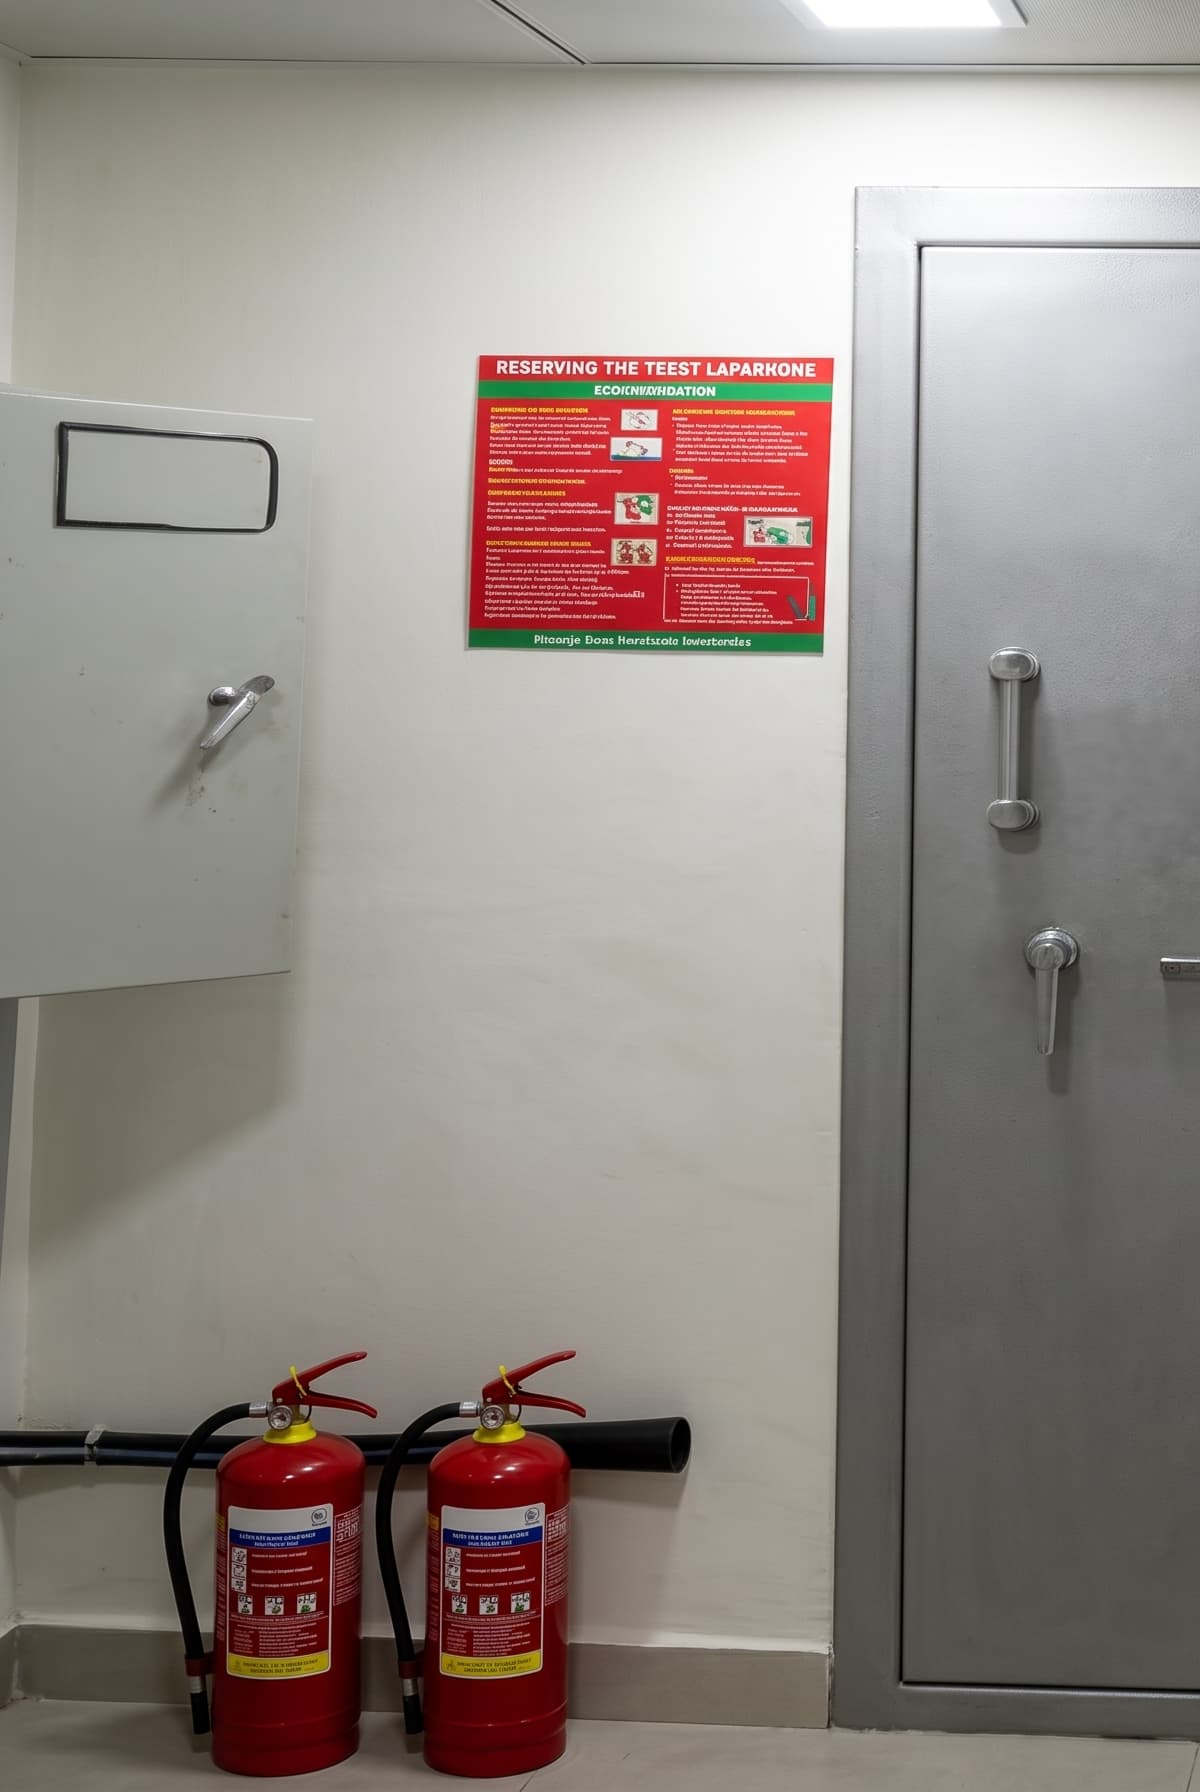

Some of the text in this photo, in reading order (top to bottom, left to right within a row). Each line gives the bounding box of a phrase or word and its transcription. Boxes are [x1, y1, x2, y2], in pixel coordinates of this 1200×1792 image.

[496, 360, 817, 377] RESERVING THE TEEST LAPARKONE
